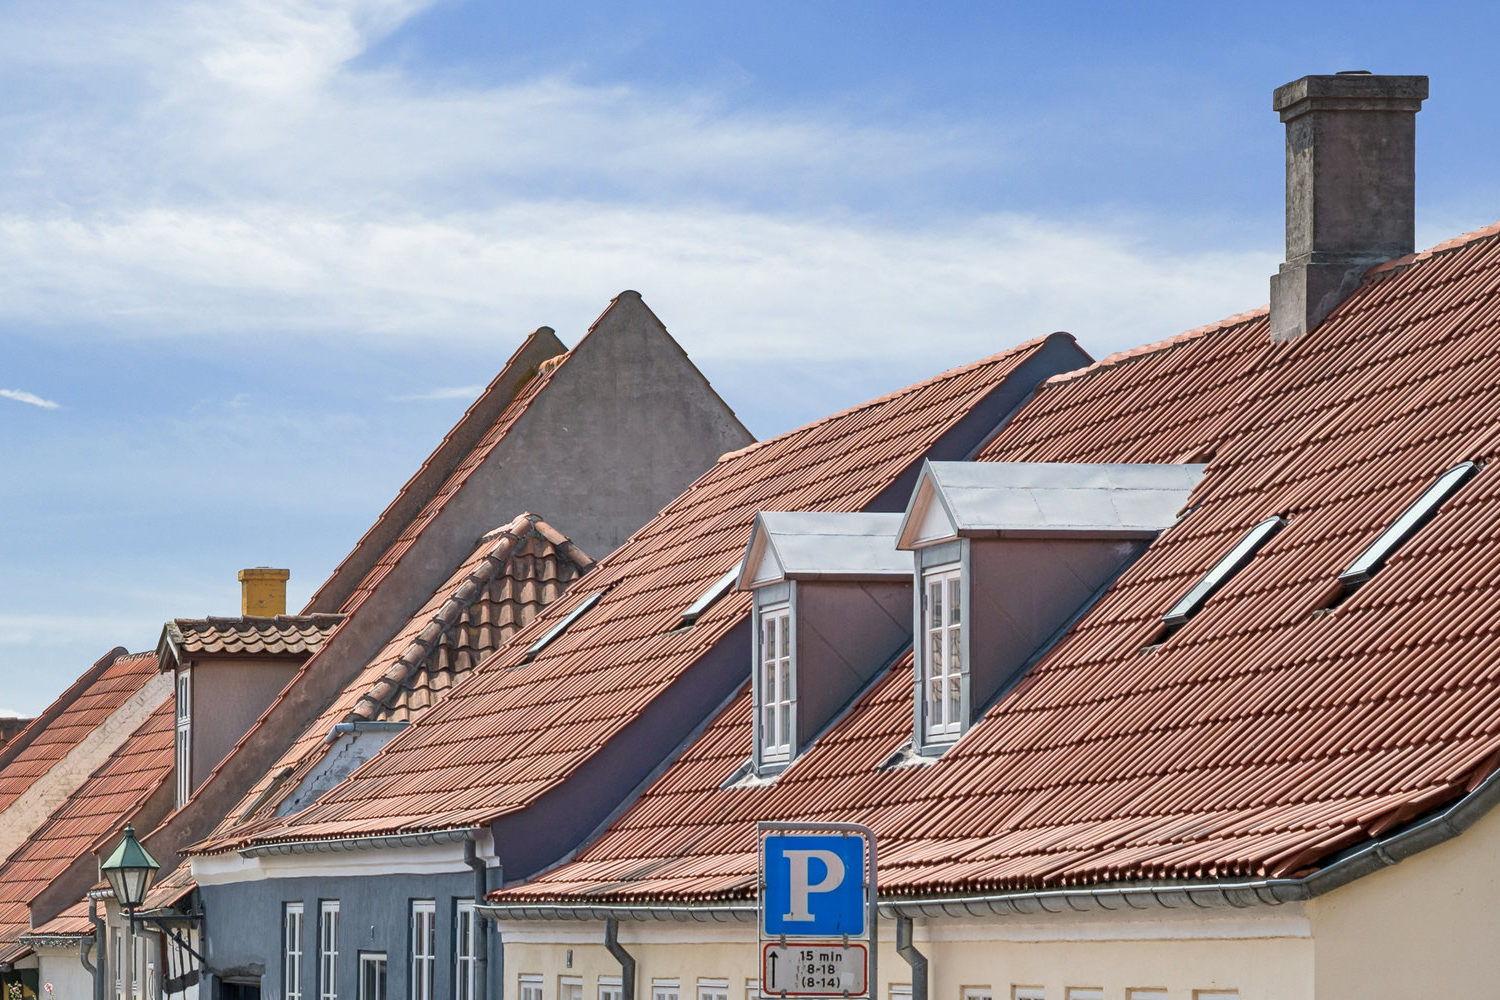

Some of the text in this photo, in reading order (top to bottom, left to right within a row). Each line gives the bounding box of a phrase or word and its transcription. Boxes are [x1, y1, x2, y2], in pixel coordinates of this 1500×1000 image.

[783, 850, 845, 921] P
[800, 950, 842, 962] 15 min
[807, 963, 835, 975] 8-18
[801, 976, 840, 989] (8-14)
